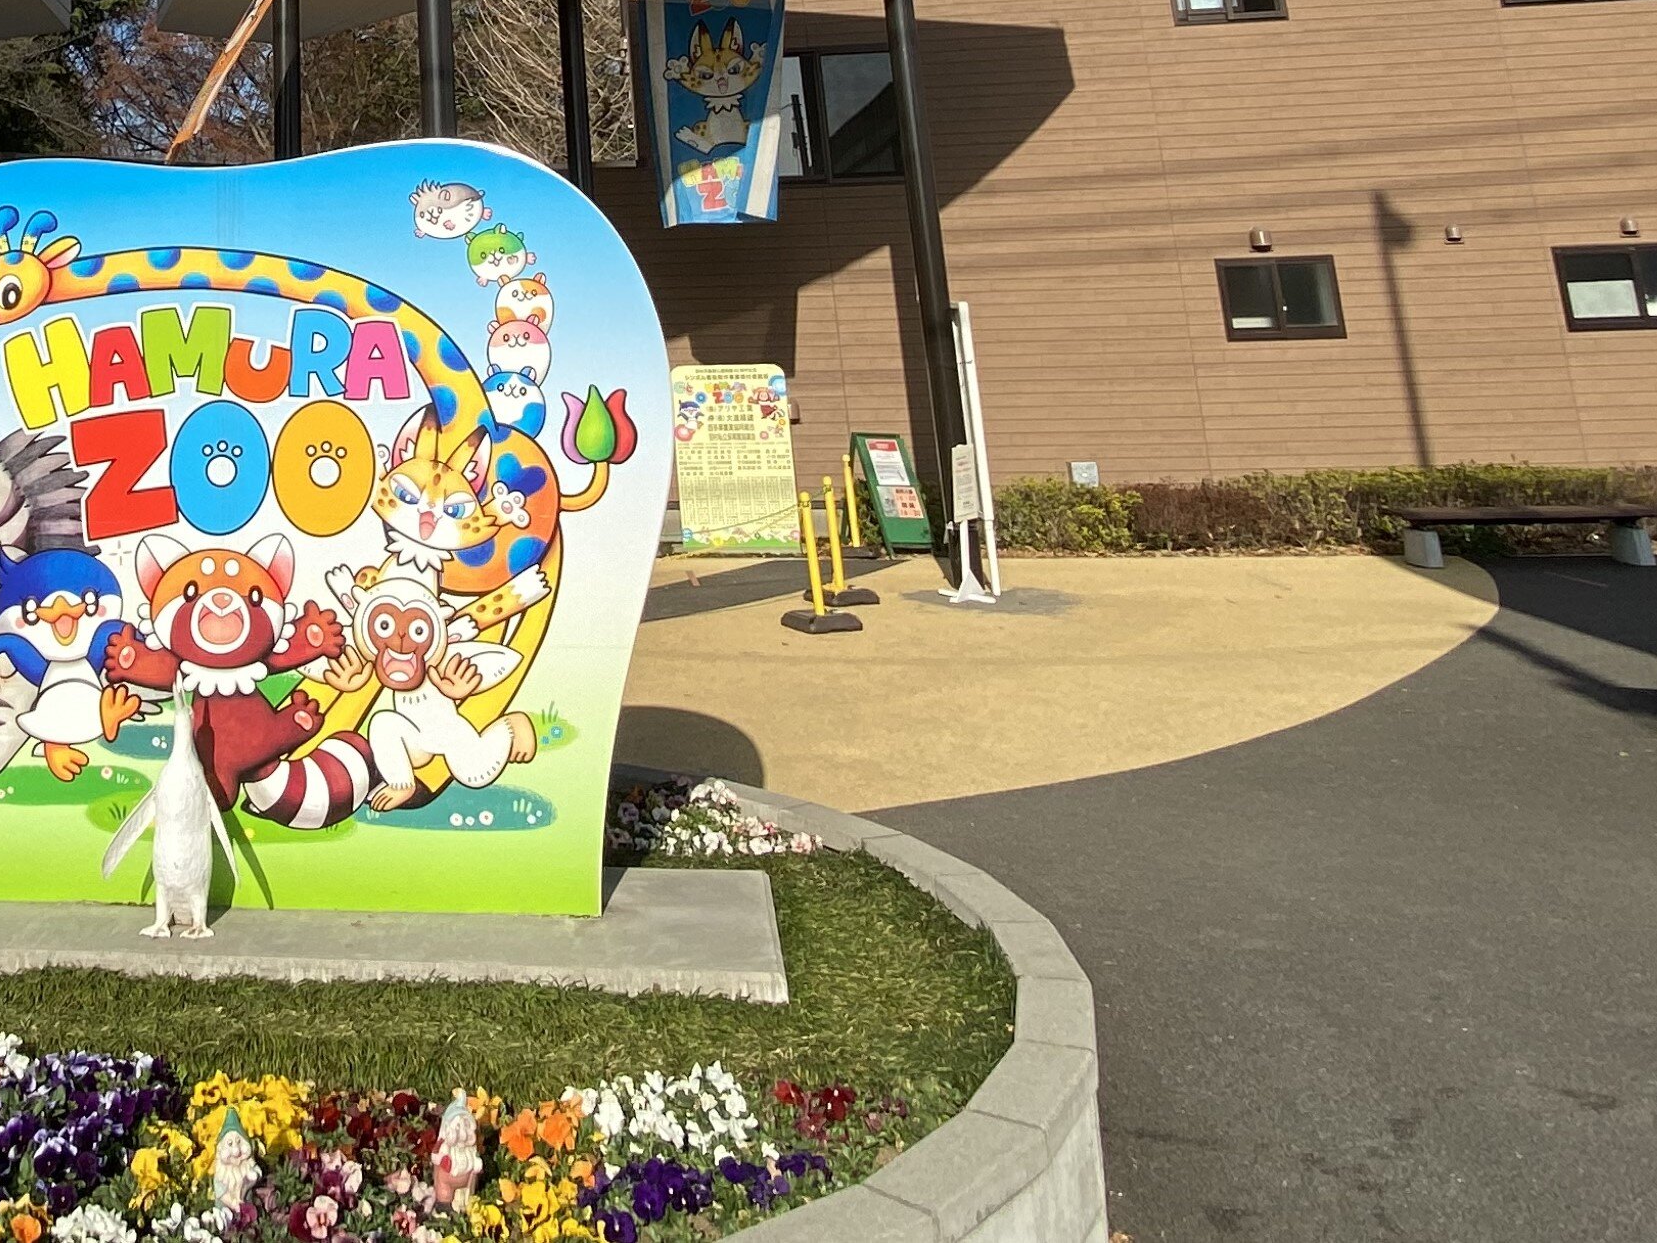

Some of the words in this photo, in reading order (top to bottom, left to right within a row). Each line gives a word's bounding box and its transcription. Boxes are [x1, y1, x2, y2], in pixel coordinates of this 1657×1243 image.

[3, 306, 410, 430] HAMURA
[712, 391, 744, 404] ZOO
[70, 399, 377, 540] ZOO
